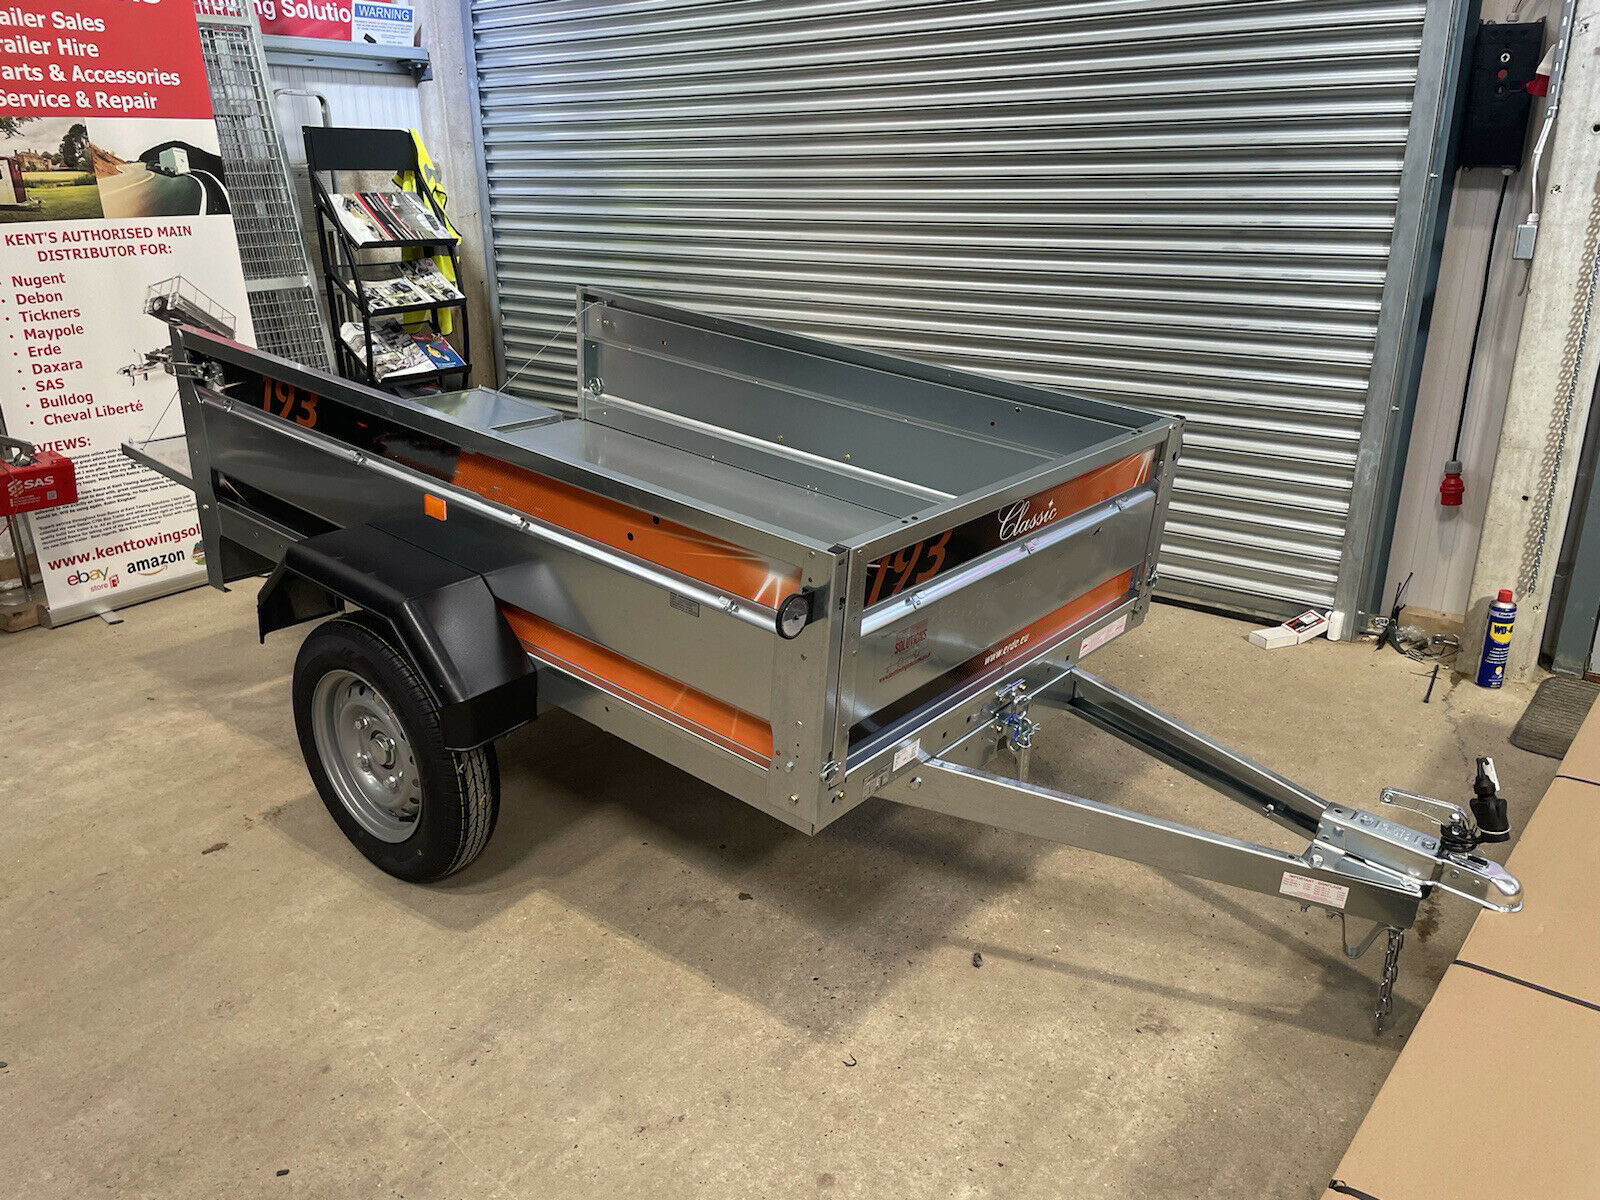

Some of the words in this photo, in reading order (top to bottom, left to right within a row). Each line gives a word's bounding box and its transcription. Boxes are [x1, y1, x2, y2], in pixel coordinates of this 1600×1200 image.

[53, 11, 105, 32] Sales
[358, 5, 410, 21] WARNING
[58, 37, 99, 58] Hire
[49, 64, 67, 82] &
[72, 65, 181, 86] Accessories
[0, 91, 70, 108] Service
[75, 90, 91, 109] &
[96, 91, 158, 113] Repair
[5, 232, 58, 247] KENT'S
[62, 227, 154, 243] AUTHORISED
[157, 225, 192, 238] MAIN
[37, 246, 137, 263] DISTRIBUTOR
[140, 243, 173, 256] FOR:
[11, 272, 66, 289] Nugent
[15, 290, 63, 306] Debon
[19, 307, 81, 324] Tickners
[23, 323, 85, 342] Maypole
[28, 344, 62, 358] Erde
[31, 358, 83, 376] Daxara
[35, 377, 65, 393] SAS
[39, 391, 94, 410] Bulldog
[262, 375, 318, 428] 193
[43, 411, 92, 427] Cheval
[95, 399, 144, 418] Liberté
[24, 475, 54, 489] SAS
[997, 498, 1058, 541] Classic
[127, 550, 185, 573] amazon
[67, 566, 109, 586] ebay
